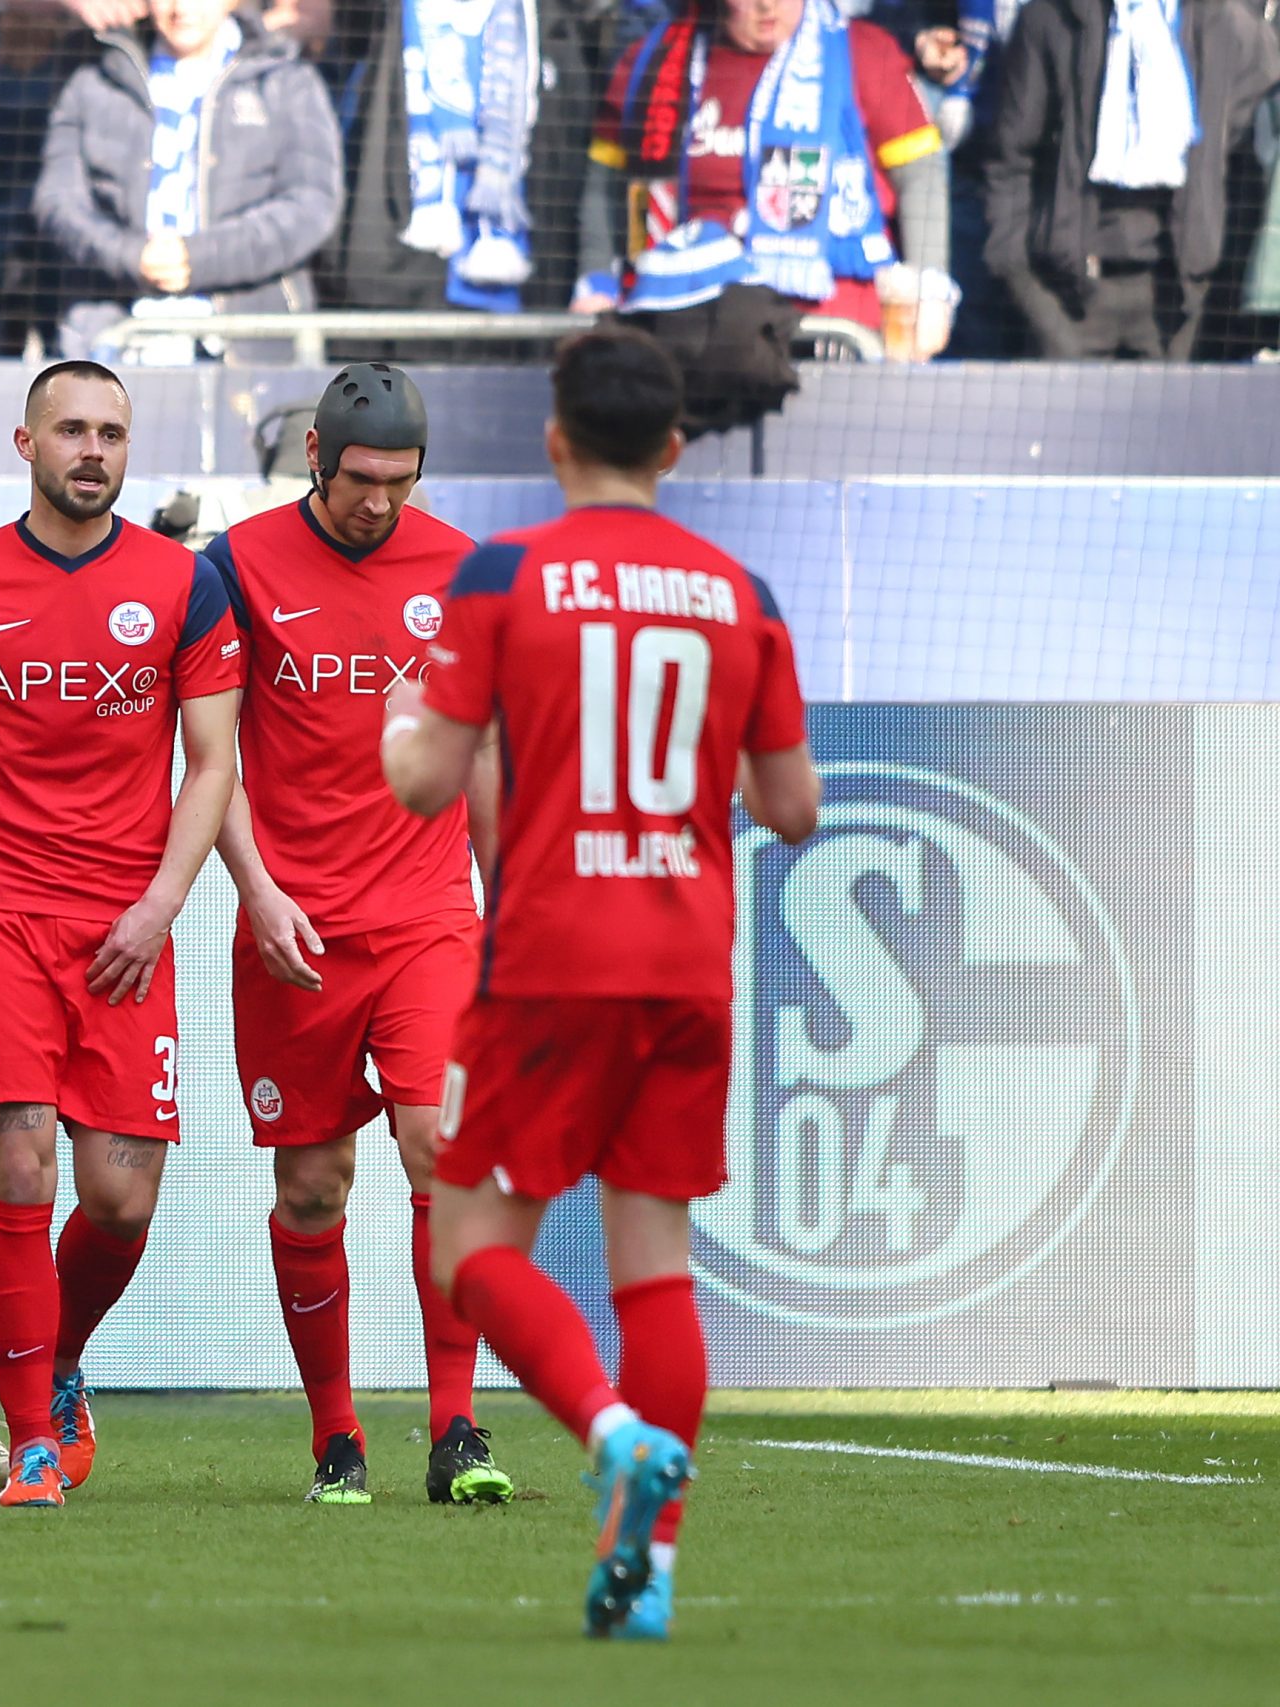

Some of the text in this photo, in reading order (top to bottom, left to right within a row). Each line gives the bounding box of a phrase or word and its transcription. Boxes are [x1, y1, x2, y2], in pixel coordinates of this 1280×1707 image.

[541, 559, 738, 626] F.C. HANSA
[96, 696, 155, 717] GROUP
[274, 652, 417, 694] APEX
[580, 621, 713, 817] 10
[774, 834, 922, 1087] S
[778, 1092, 921, 1254] 04
